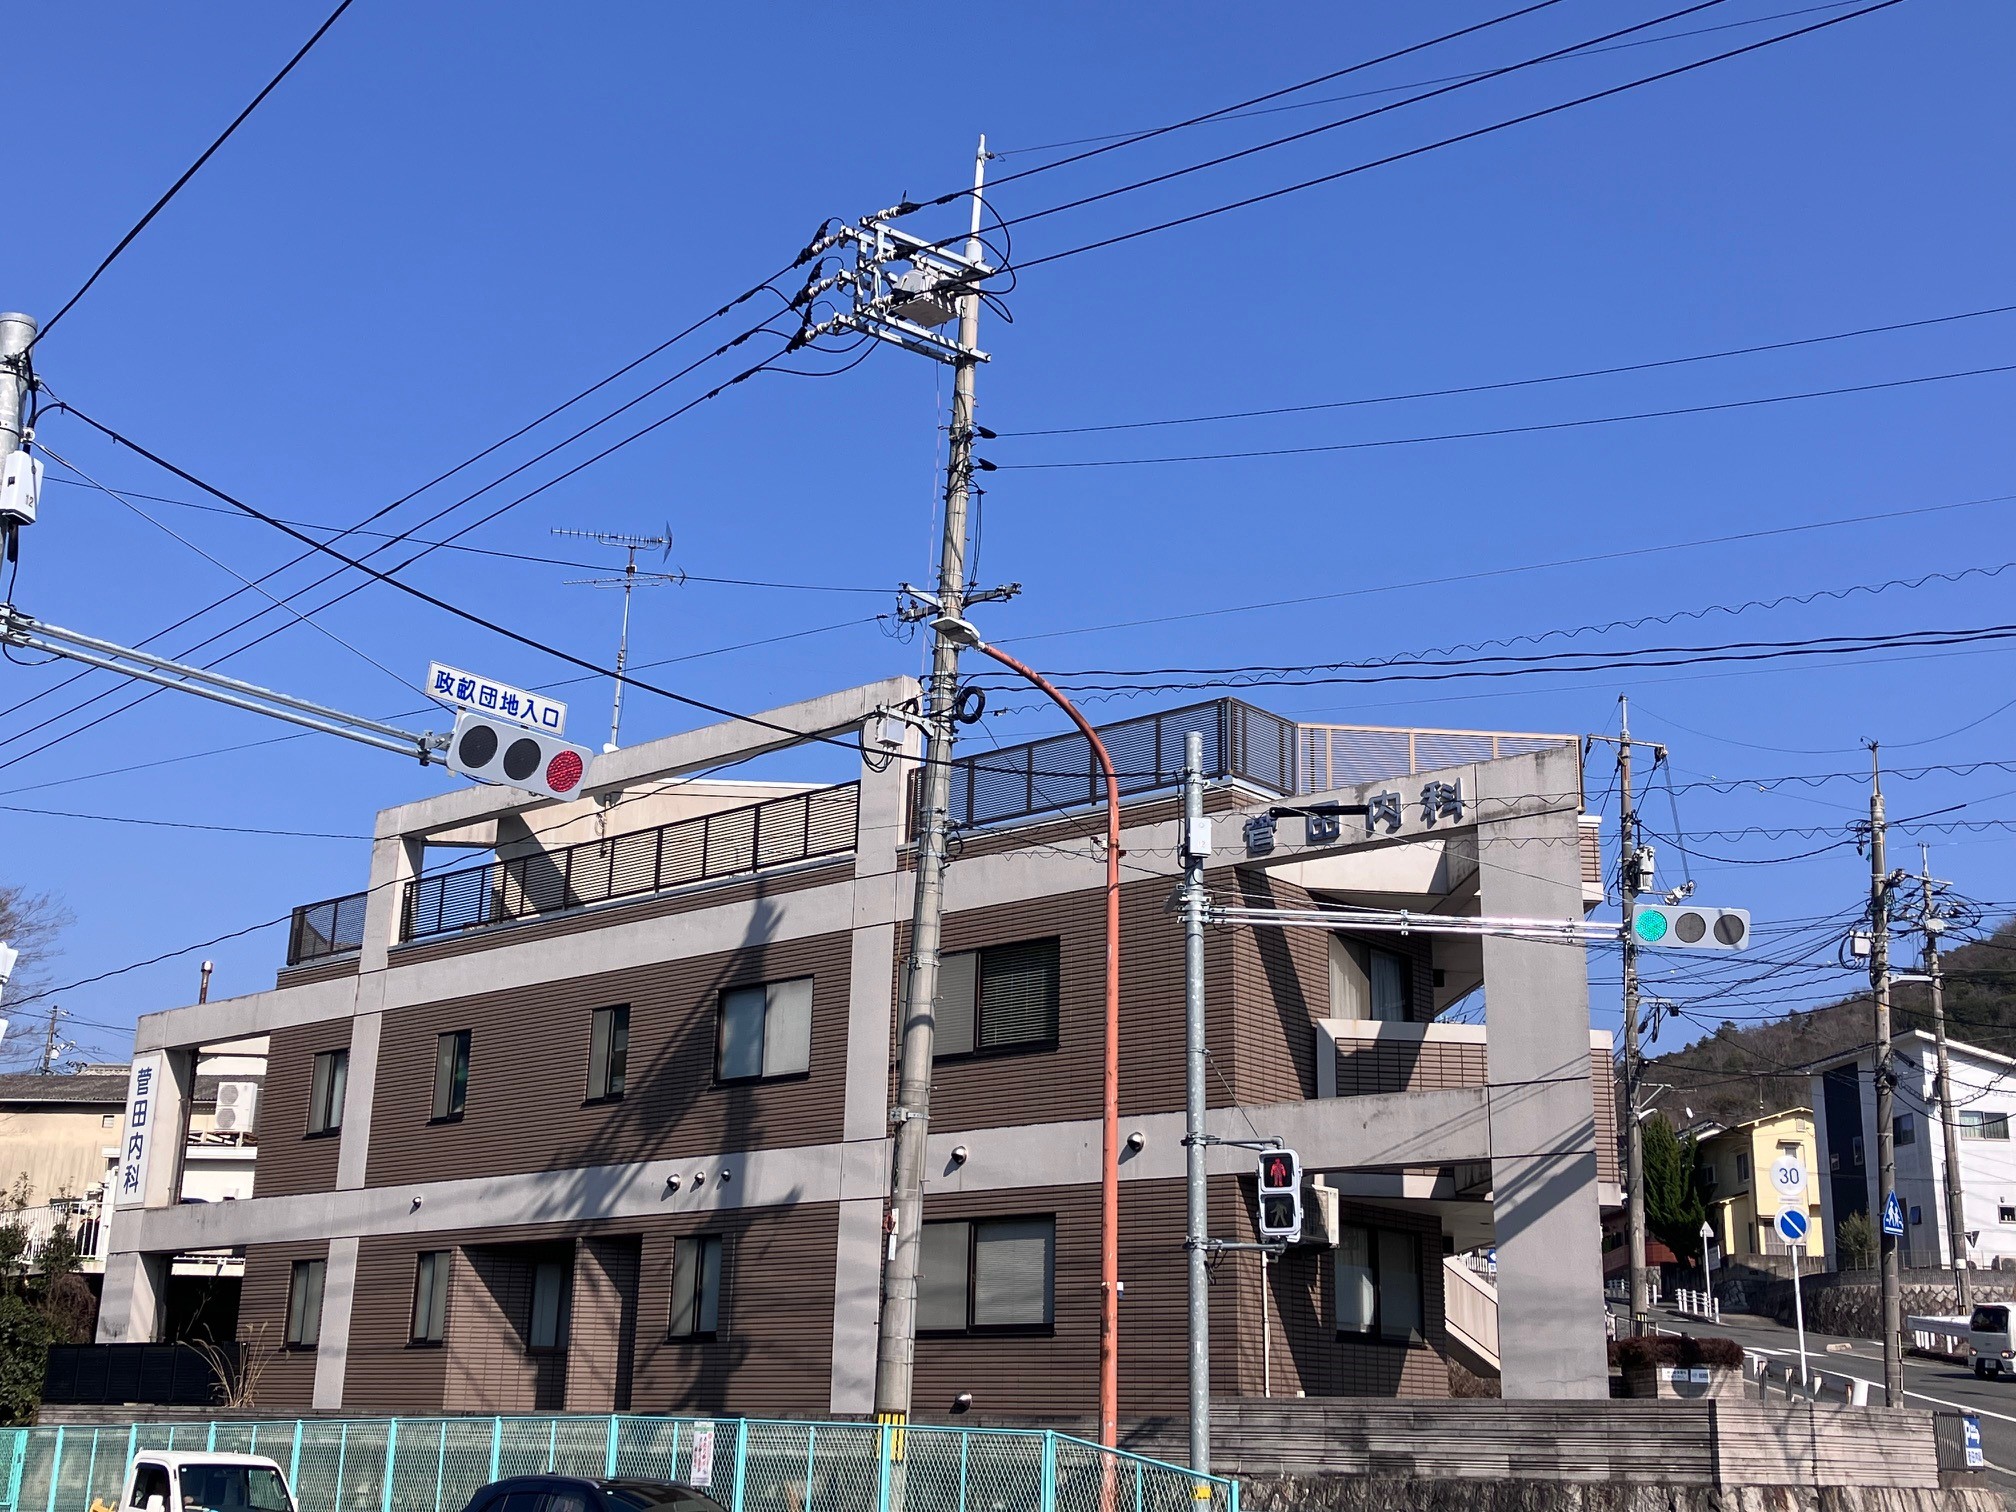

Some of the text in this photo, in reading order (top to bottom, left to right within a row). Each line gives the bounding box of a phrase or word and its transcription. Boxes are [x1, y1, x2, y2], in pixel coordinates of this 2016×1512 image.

[123, 1066, 153, 1195] 菅田内科
[1779, 1167, 1800, 1184] 30
